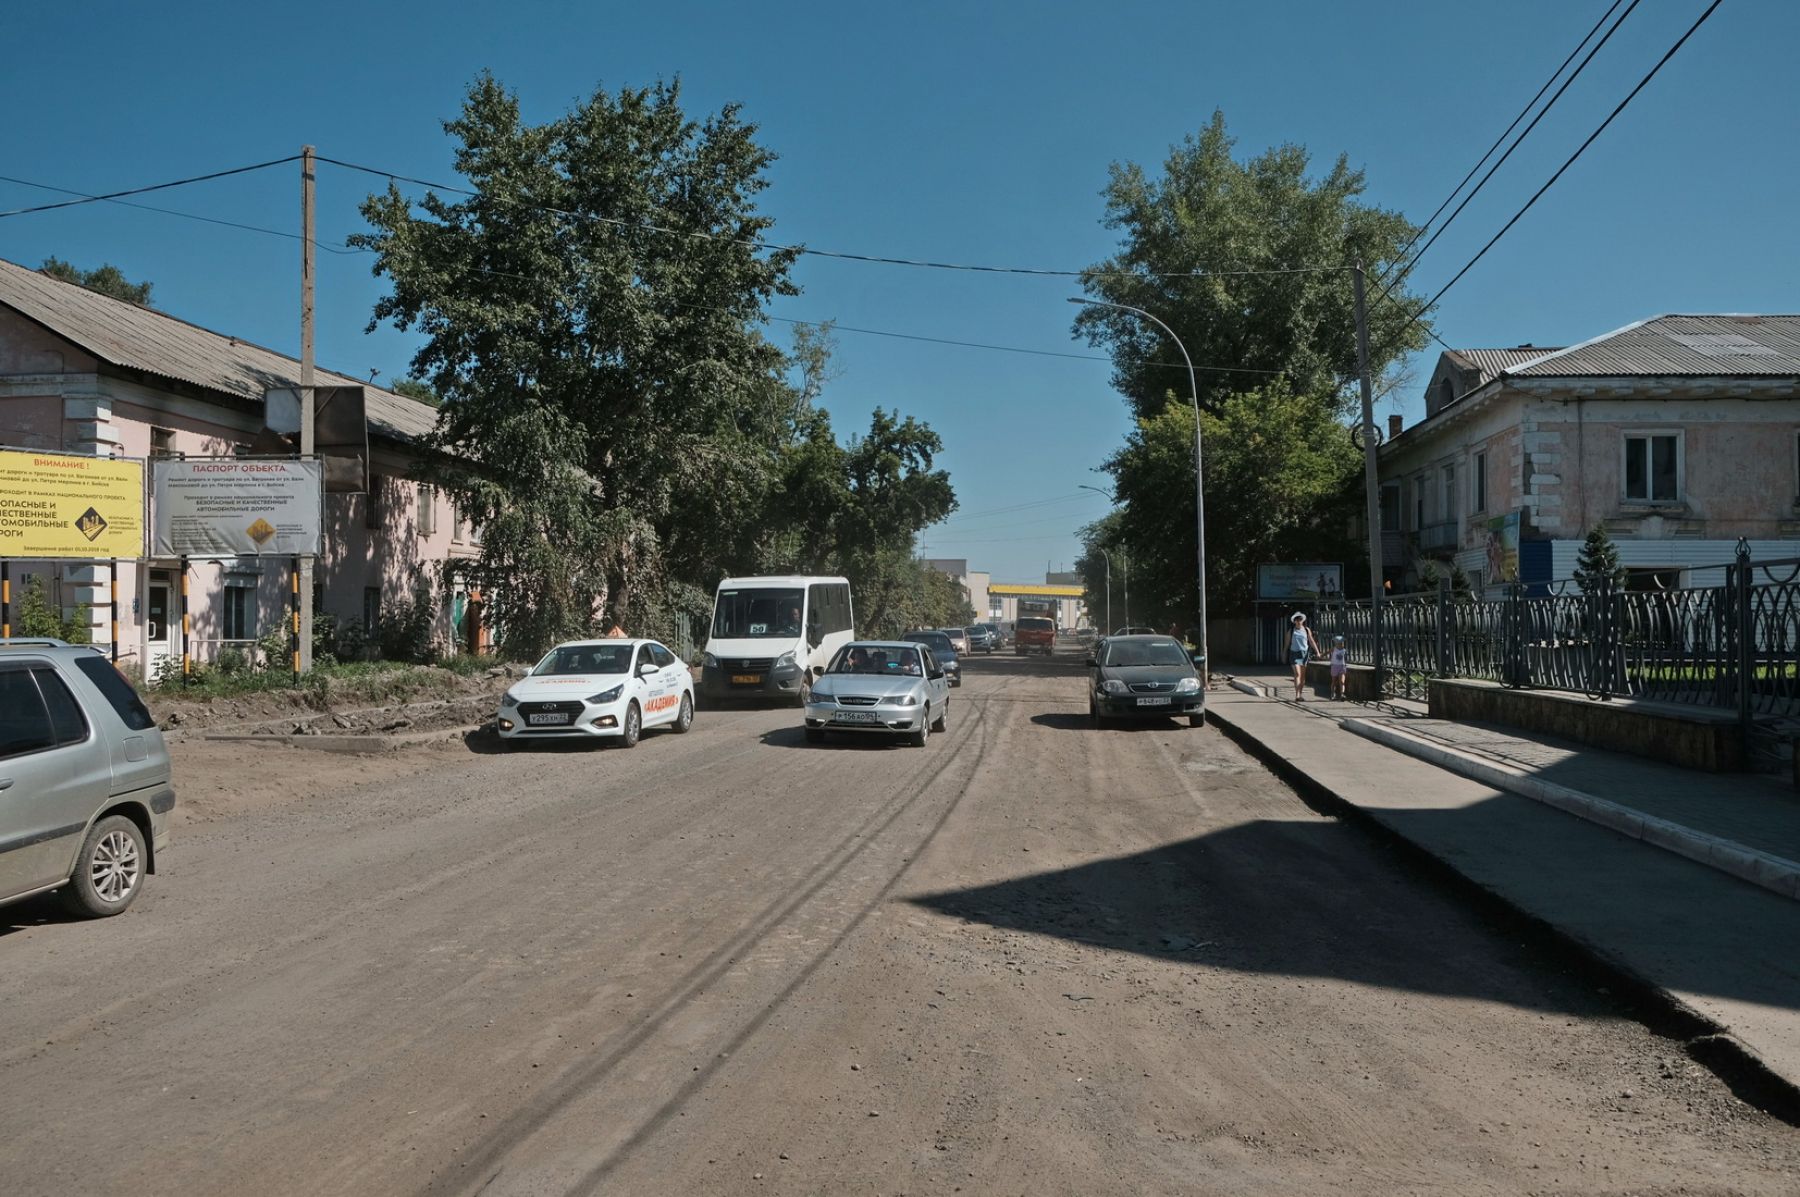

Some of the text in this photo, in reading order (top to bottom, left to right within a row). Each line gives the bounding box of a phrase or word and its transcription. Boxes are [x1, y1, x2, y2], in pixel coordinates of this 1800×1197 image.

[34, 458, 85, 470] ВНИМАНИЕ
[193, 464, 238, 473] ПАСПОРТ
[0, 509, 57, 519] ЕСТВЕННЫЕ
[0, 518, 69, 529] ОМОБИЛЬНЫЕ
